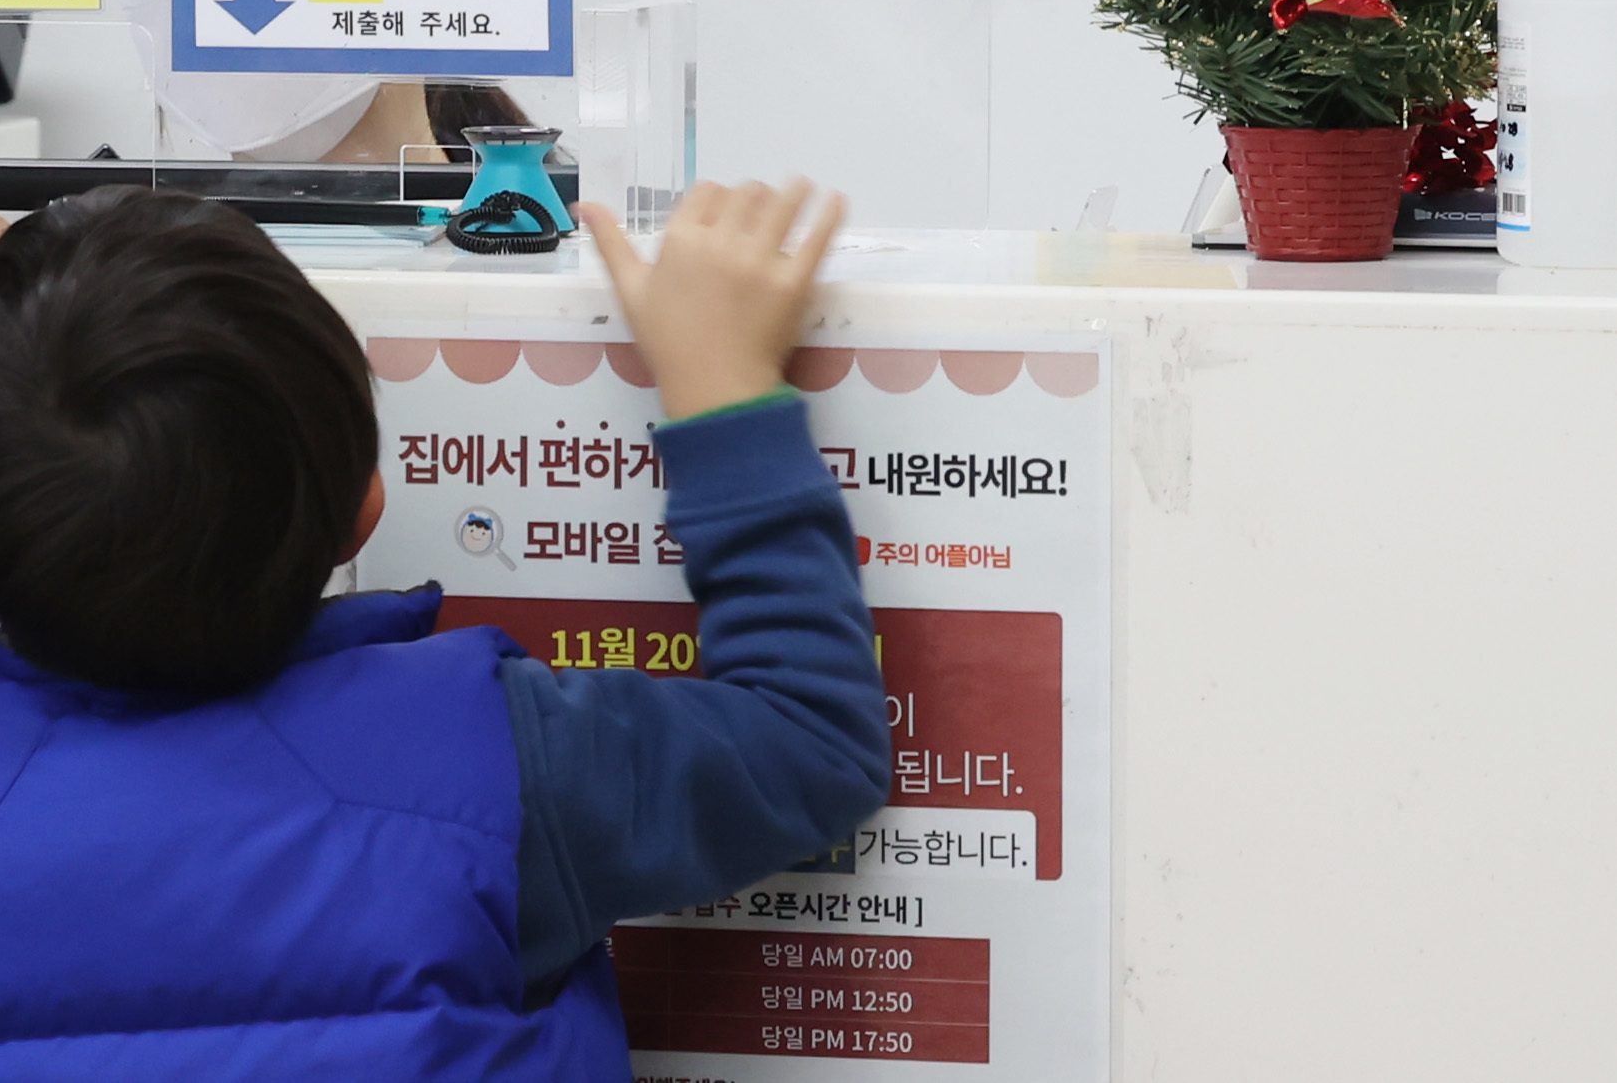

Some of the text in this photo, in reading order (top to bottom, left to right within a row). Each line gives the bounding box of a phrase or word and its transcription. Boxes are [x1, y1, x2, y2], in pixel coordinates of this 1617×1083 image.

[332, 10, 500, 37] 제출해 주세요.
[398, 434, 529, 488] 집에서
[868, 452, 1067, 498] 내원하세요!
[523, 522, 640, 565] 모바일
[875, 542, 919, 567] 주의
[925, 542, 1011, 568] 어플아님
[550, 627, 635, 669] 11월
[895, 751, 1024, 797] 됩니다.
[859, 828, 1028, 868] 가능합니다.
[749, 892, 851, 922] 오픈시간
[857, 895, 907, 924] 안내
[761, 943, 912, 970] 당일 AM 07:00
[761, 985, 912, 1013] 당일 PM 12:50
[761, 1026, 912, 1053] 당일 PM 17:50
